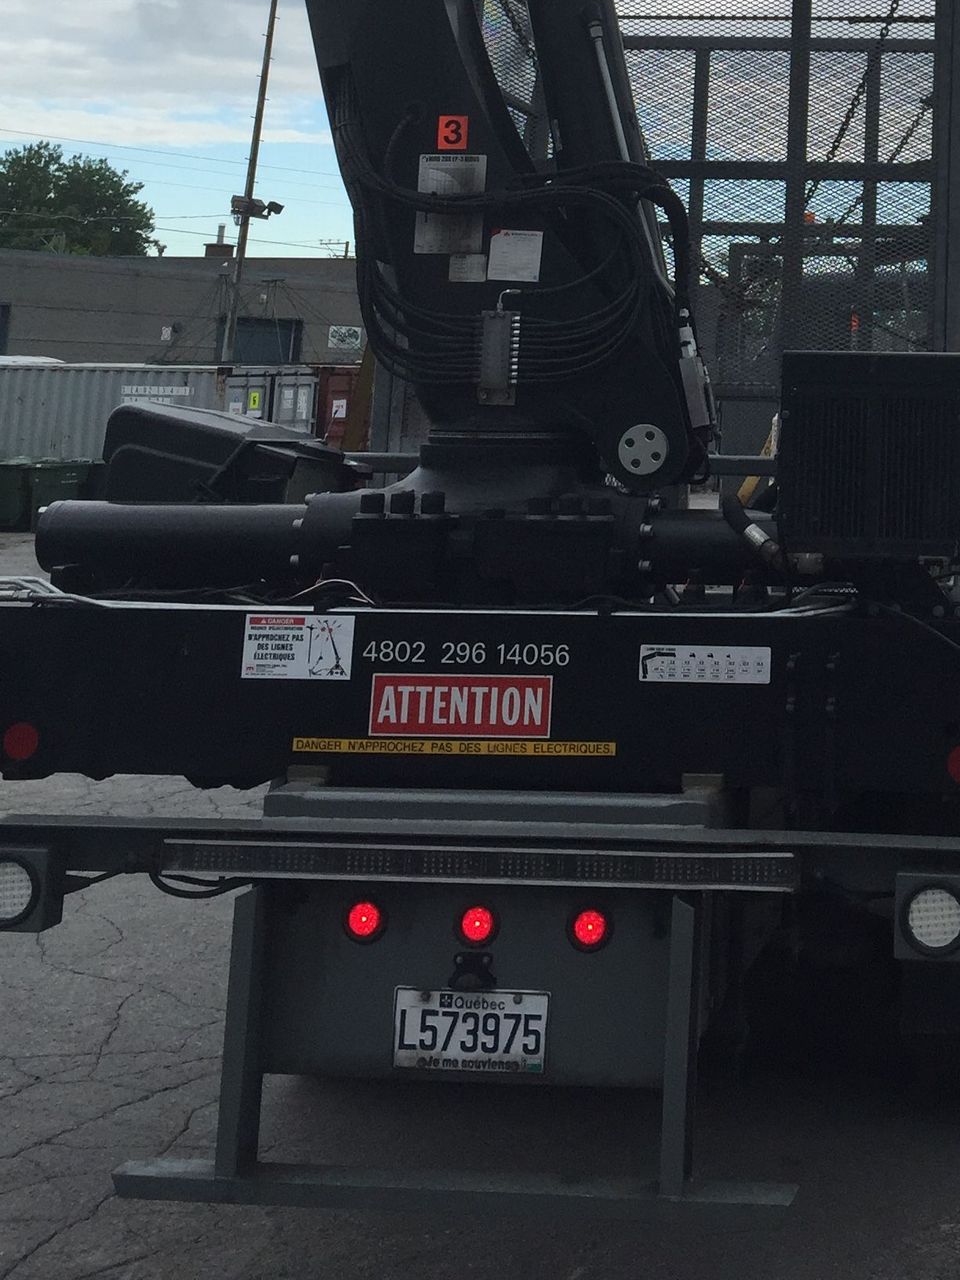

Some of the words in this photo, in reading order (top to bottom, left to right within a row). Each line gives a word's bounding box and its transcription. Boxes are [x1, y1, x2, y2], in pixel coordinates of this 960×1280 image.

[443, 120, 462, 144] 3
[291, 634, 304, 642] PAS
[257, 643, 270, 651] DES
[271, 643, 294, 651] LIGNES
[362, 640, 426, 664] 4802
[441, 641, 486, 665] 296
[496, 642, 570, 667] 14056
[376, 683, 543, 726] ATTENTION
[295, 739, 342, 751] DANGER
[348, 740, 425, 752] N'APPROCHEZ
[431, 742, 453, 753] PAS
[459, 742, 481, 753] DES
[487, 742, 527, 754] LIGNES
[454, 996, 506, 1011] Québec
[398, 1008, 543, 1056] L573975
[442, 1058, 459, 1069] me
[461, 1059, 514, 1071] souviens
